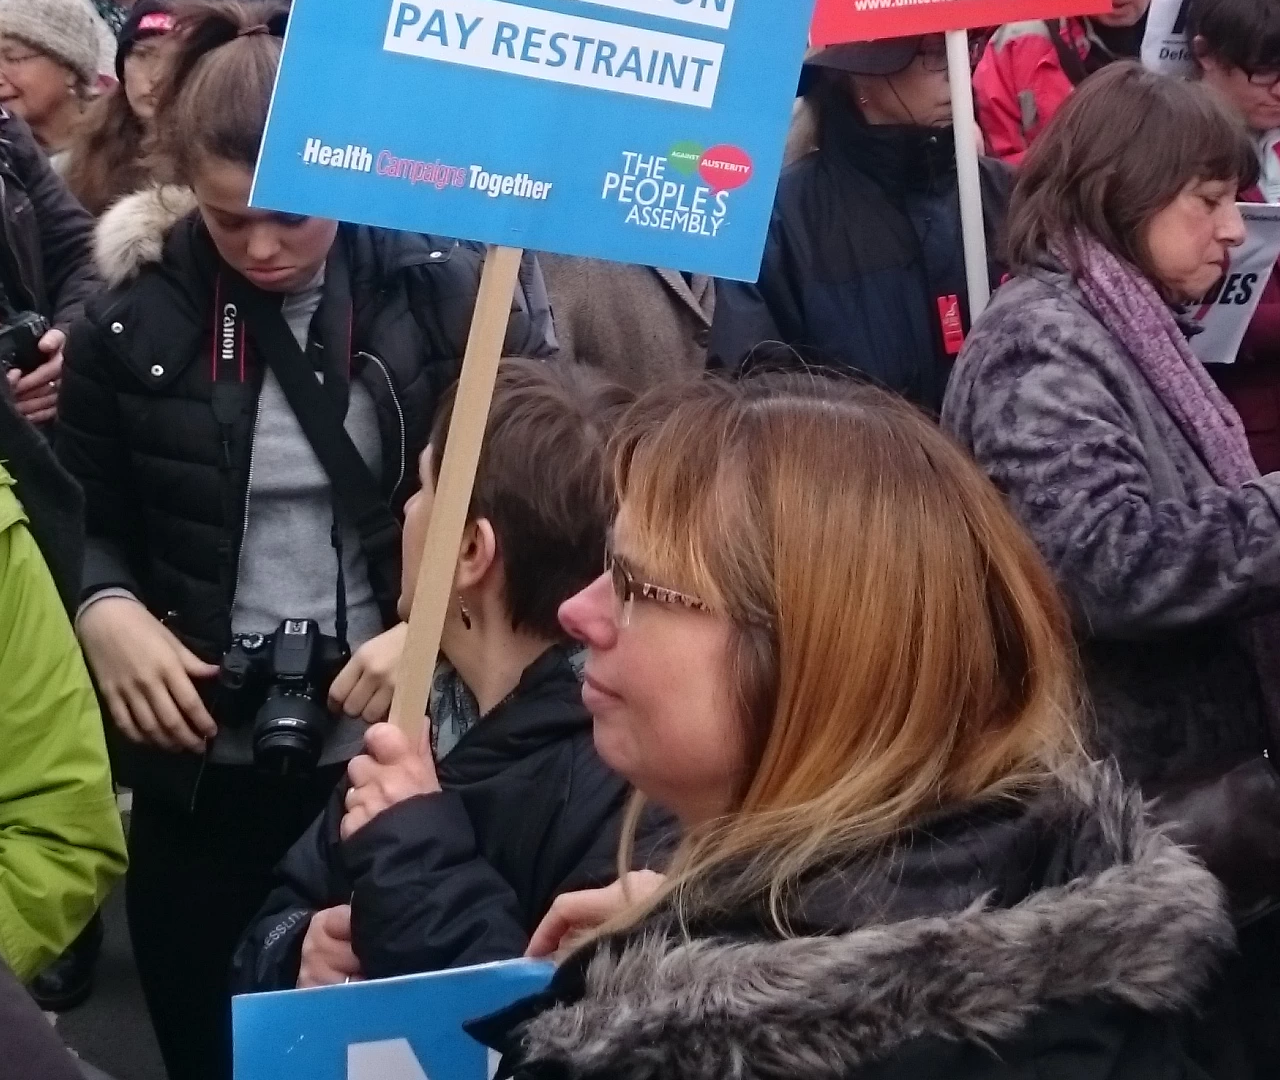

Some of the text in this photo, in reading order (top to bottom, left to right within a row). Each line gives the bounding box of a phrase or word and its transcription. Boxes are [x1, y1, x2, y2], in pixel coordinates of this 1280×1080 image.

[393, 1, 714, 93] PAY RESTRAINT
[1159, 46, 1192, 61] Defe
[302, 137, 554, 201] Health Campaigns Together
[622, 151, 668, 180] THE
[671, 150, 701, 161] AGAINST
[701, 158, 751, 174] AUSTERITY
[624, 204, 725, 237] ASSEMBLY
[1219, 272, 1257, 305] ES
[222, 302, 239, 361] Canon
